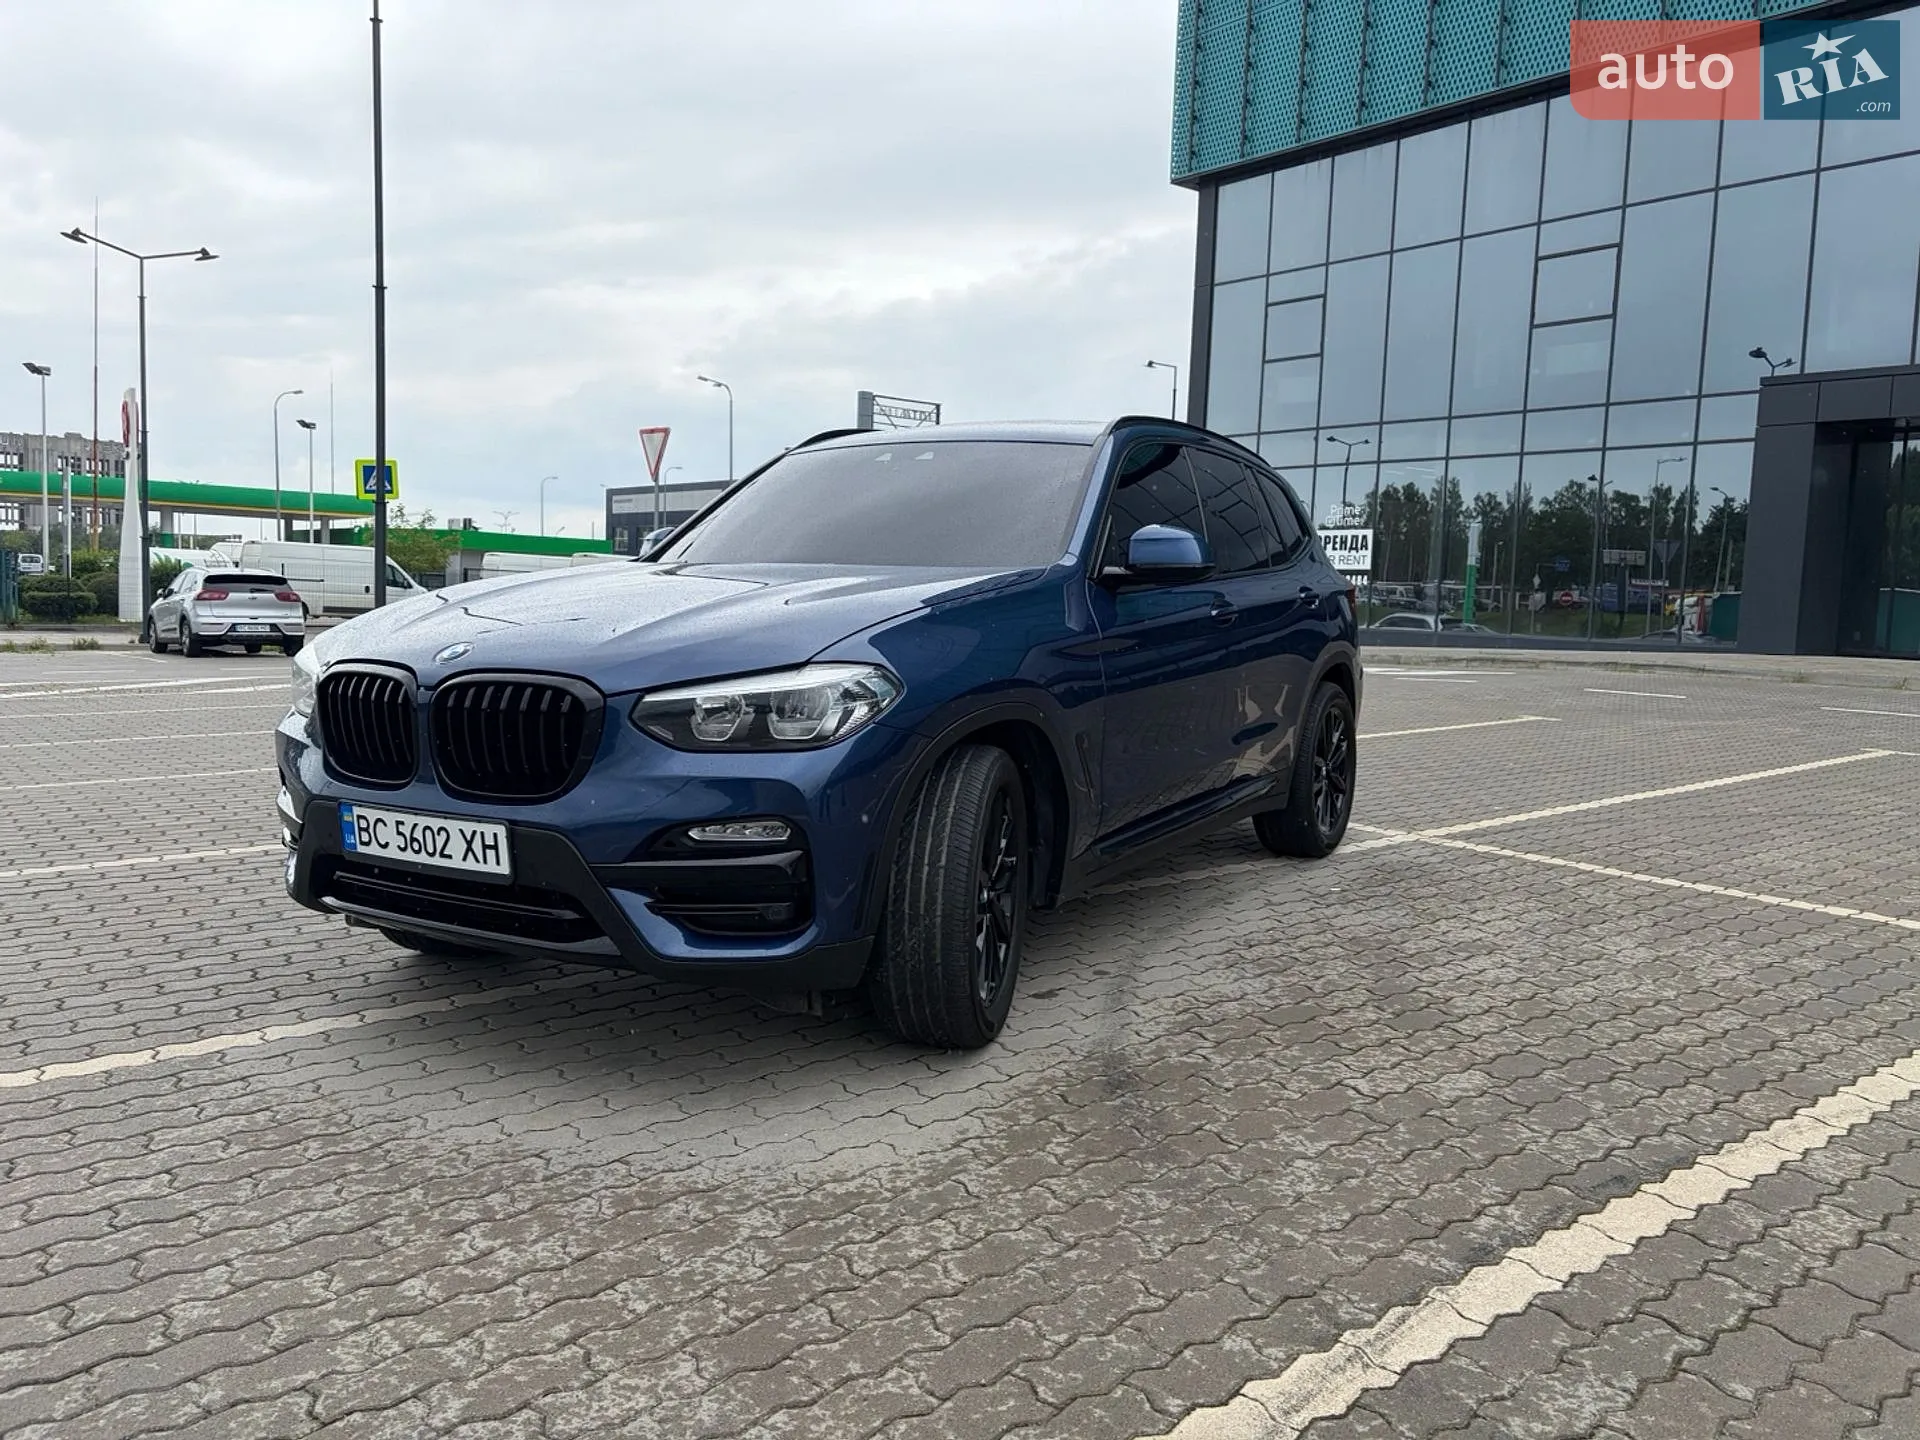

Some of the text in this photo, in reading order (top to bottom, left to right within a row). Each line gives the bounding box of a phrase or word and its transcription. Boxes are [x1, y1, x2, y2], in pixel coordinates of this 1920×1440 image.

[1319, 534, 1369, 554] РЕНДА
[1338, 554, 1368, 566] RENT
[356, 814, 501, 867] BC 5602 XH
